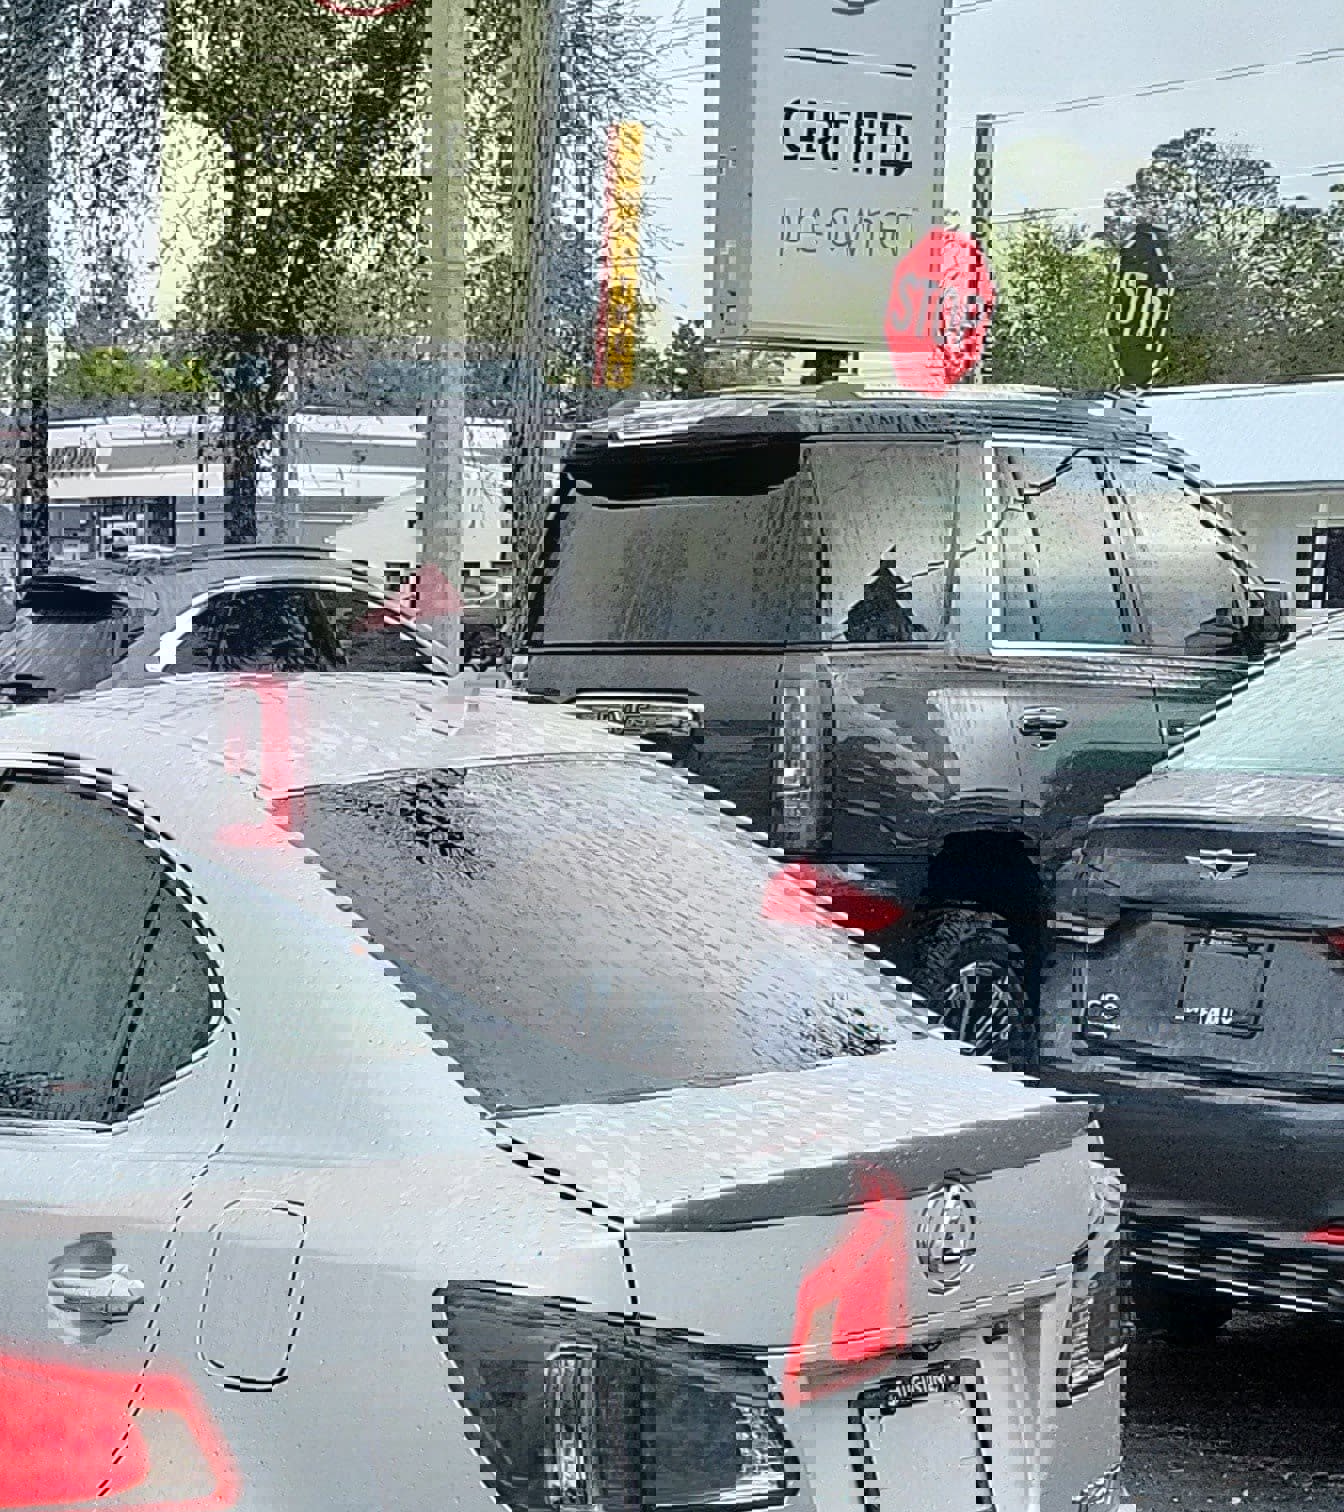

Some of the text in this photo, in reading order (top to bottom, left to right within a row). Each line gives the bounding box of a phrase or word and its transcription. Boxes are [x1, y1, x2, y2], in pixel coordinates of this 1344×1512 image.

[221, 106, 479, 179] CERTIFIED
[890, 271, 986, 353] STOP
[843, 998, 895, 1020] G80
[1054, 1011, 1122, 1033] FAMILY
[462, 1376, 538, 1404] AUGUSTINE,
